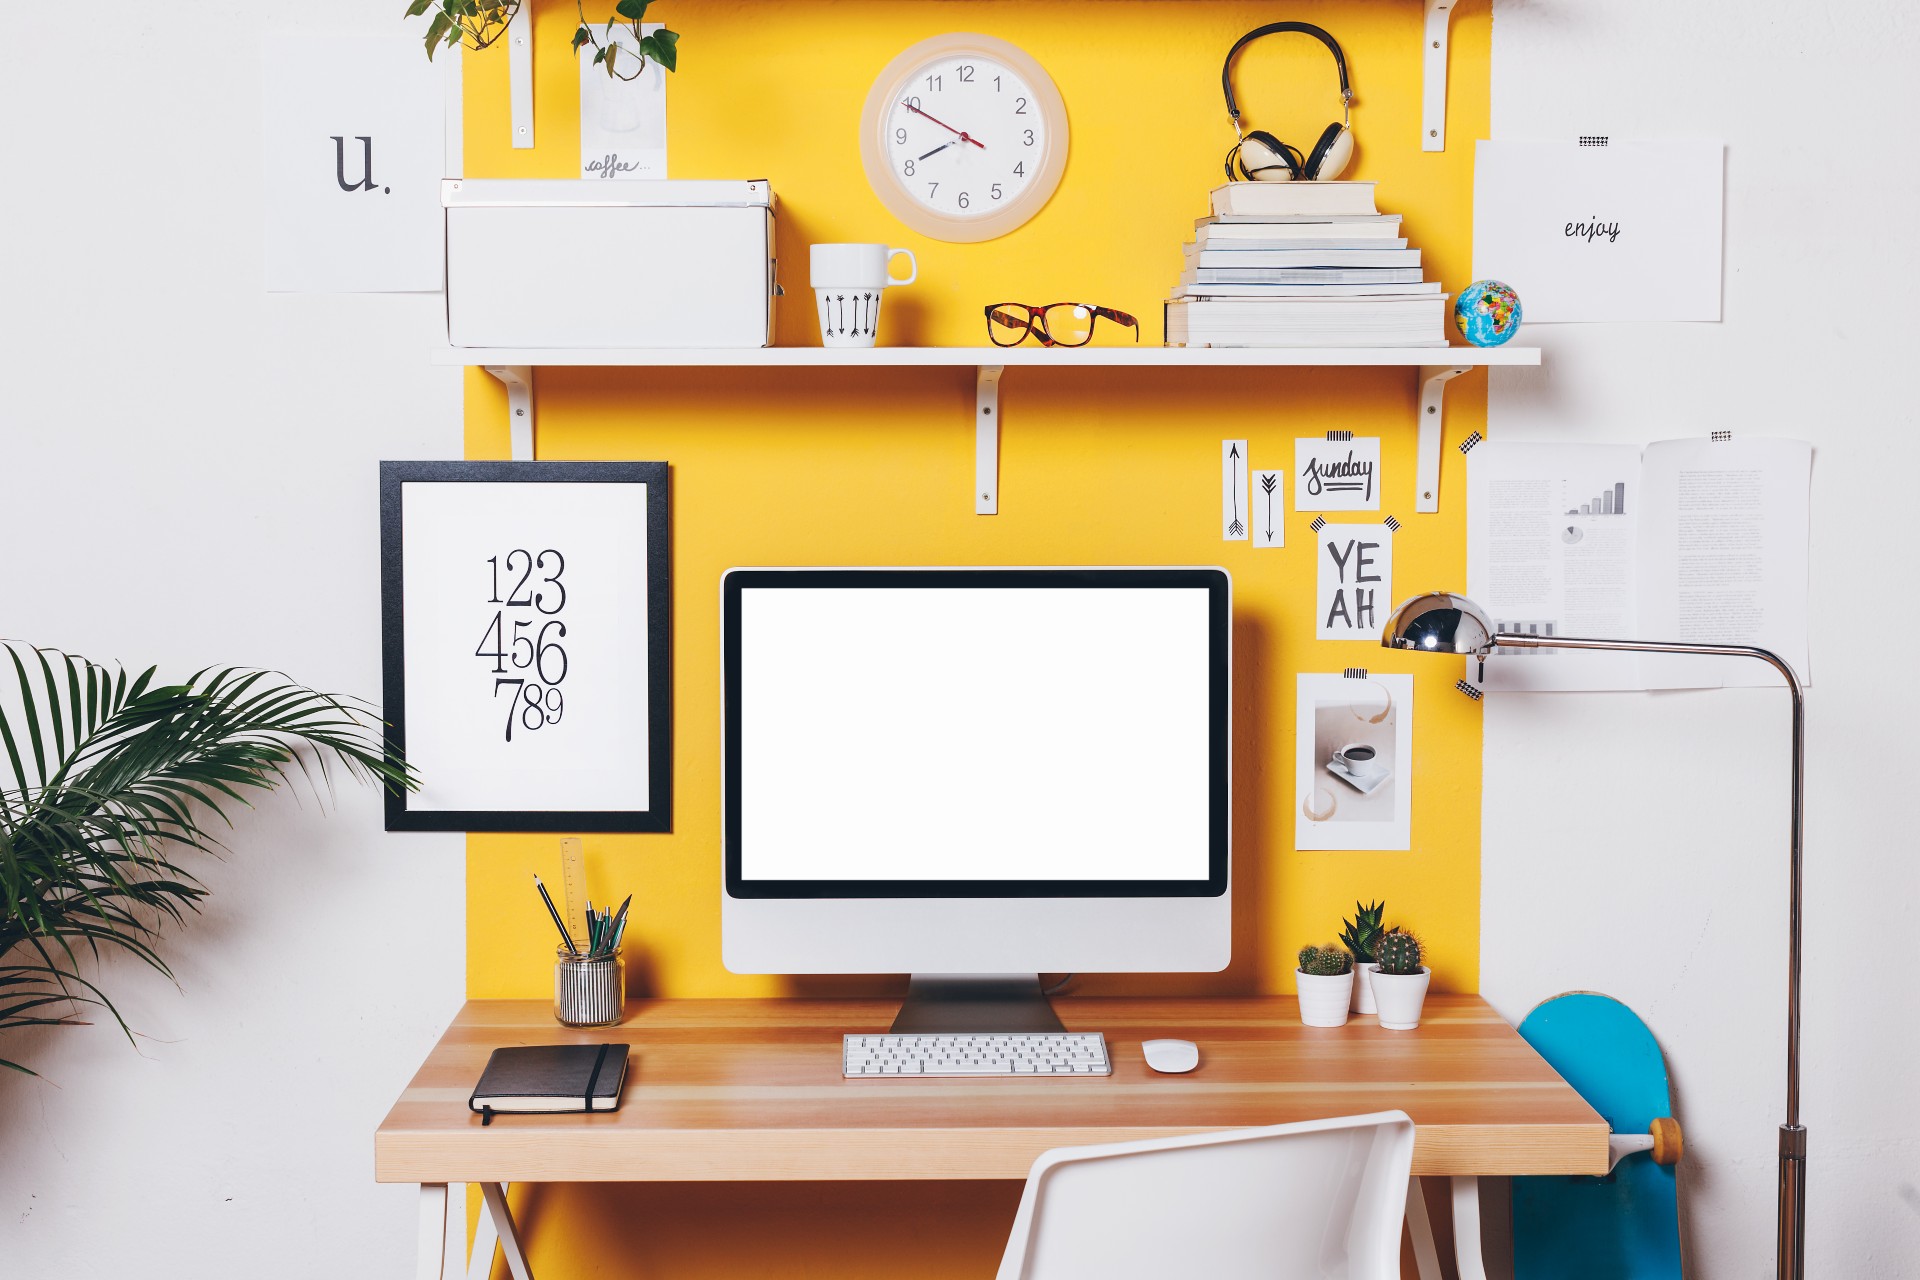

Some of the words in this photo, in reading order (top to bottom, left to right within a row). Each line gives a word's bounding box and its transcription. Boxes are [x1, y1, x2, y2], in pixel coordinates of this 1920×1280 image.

[955, 65, 975, 82] 12
[926, 75, 942, 92] 11
[993, 75, 1001, 92] 1
[902, 96, 921, 113] 10
[1015, 97, 1027, 115] 2
[896, 128, 907, 145] 9
[1023, 129, 1034, 146] 3
[329, 136, 391, 195] u.
[904, 159, 915, 177] 8
[1013, 160, 1025, 178] 4
[928, 182, 939, 198] 7
[990, 183, 1002, 200] 5
[958, 192, 970, 209] 6
[1564, 215, 1621, 243] enjoy
[1327, 539, 1382, 584] YE
[487, 549, 566, 615] 123
[1326, 587, 1375, 630] AH
[475, 610, 568, 686] 456
[494, 678, 564, 743] 789
